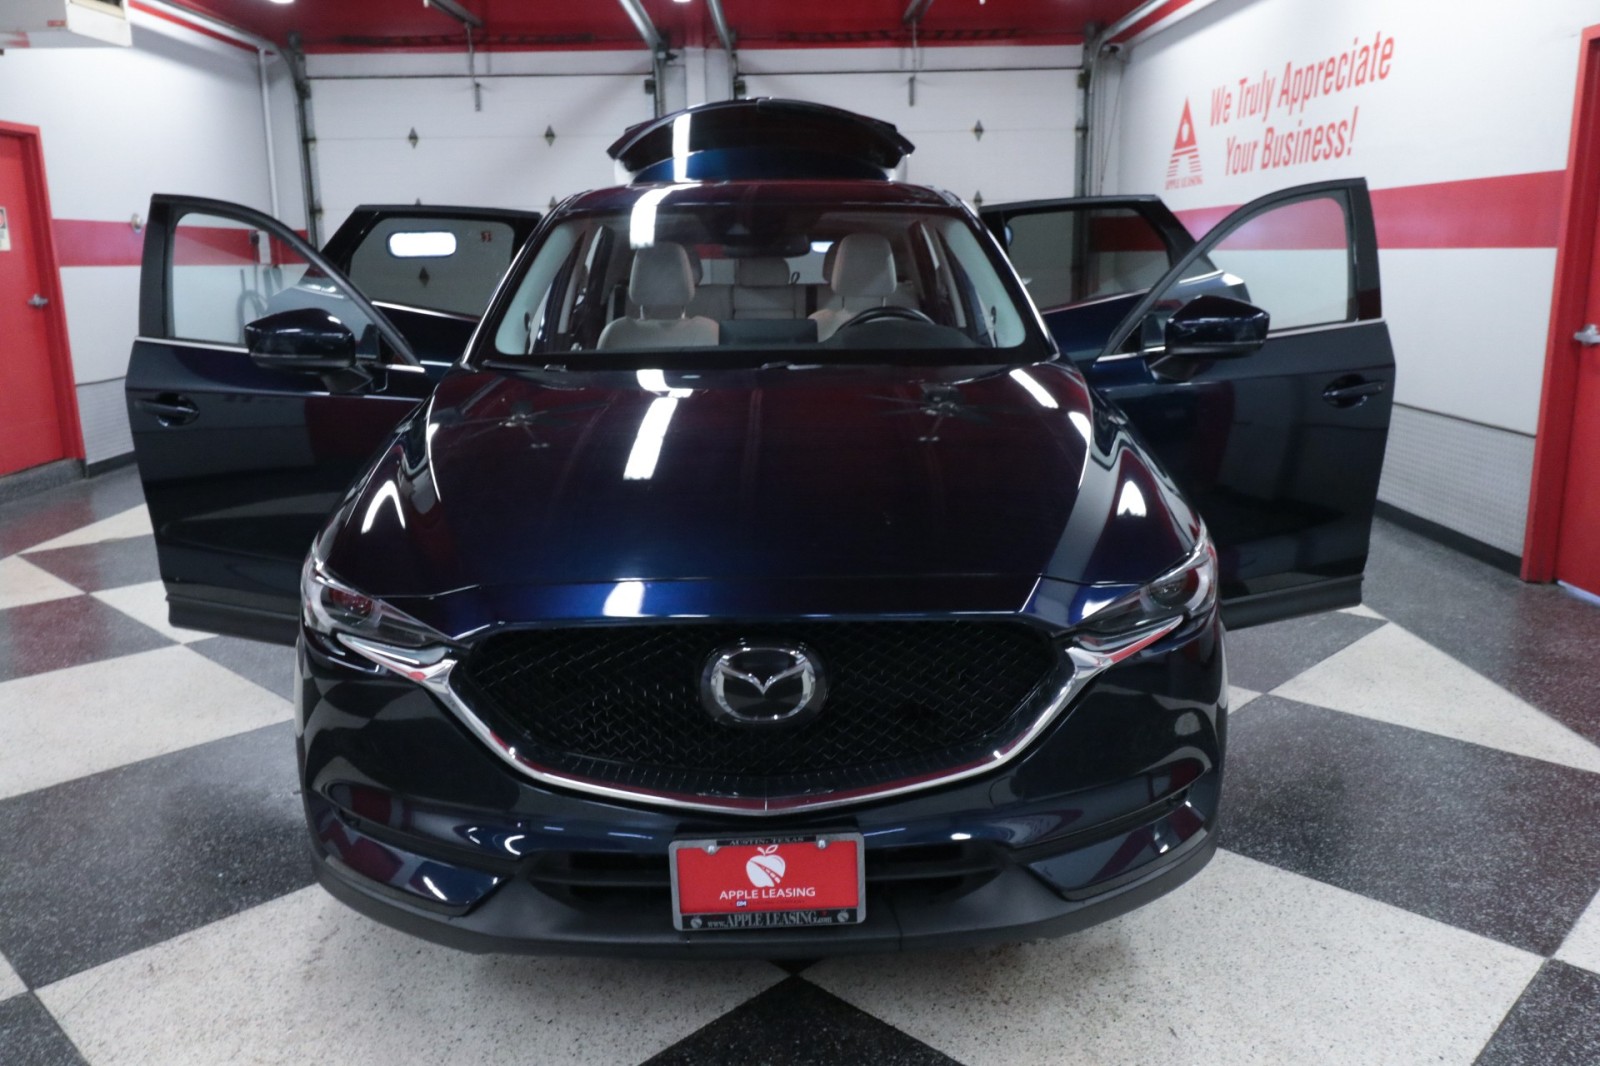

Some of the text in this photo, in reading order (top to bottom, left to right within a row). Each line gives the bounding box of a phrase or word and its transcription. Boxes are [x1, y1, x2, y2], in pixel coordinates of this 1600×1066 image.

[1210, 31, 1394, 127] We Truly Appreciate
[1225, 106, 1359, 177] Your Business!
[719, 886, 816, 900] APPLE LEASING
